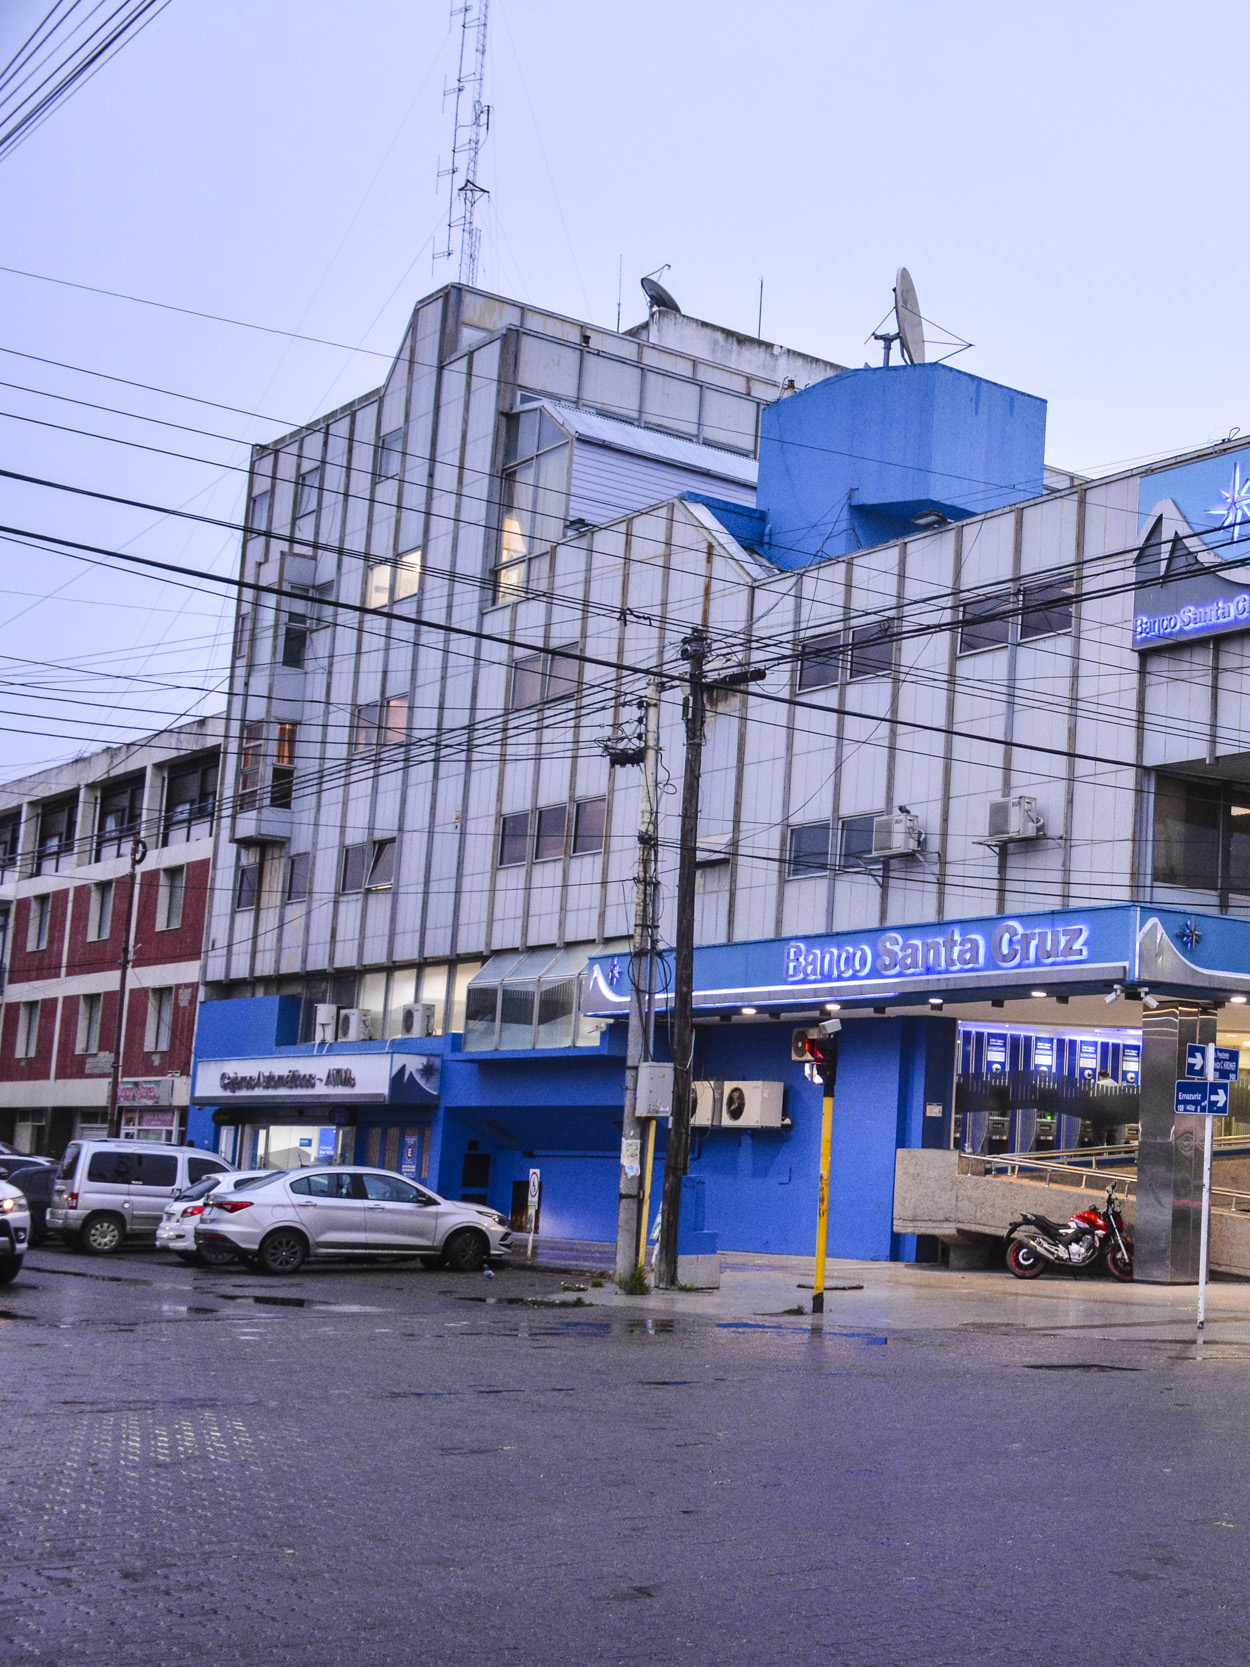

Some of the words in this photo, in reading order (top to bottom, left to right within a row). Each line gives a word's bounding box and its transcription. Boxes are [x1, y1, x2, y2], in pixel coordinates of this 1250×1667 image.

[1135, 614, 1179, 637] Banco
[1180, 602, 1232, 628] Santa
[784, 942, 872, 980] Banco
[876, 928, 984, 975] Santa
[992, 921, 1086, 966] Cruz
[1178, 1092, 1202, 1100] Errazuriz
